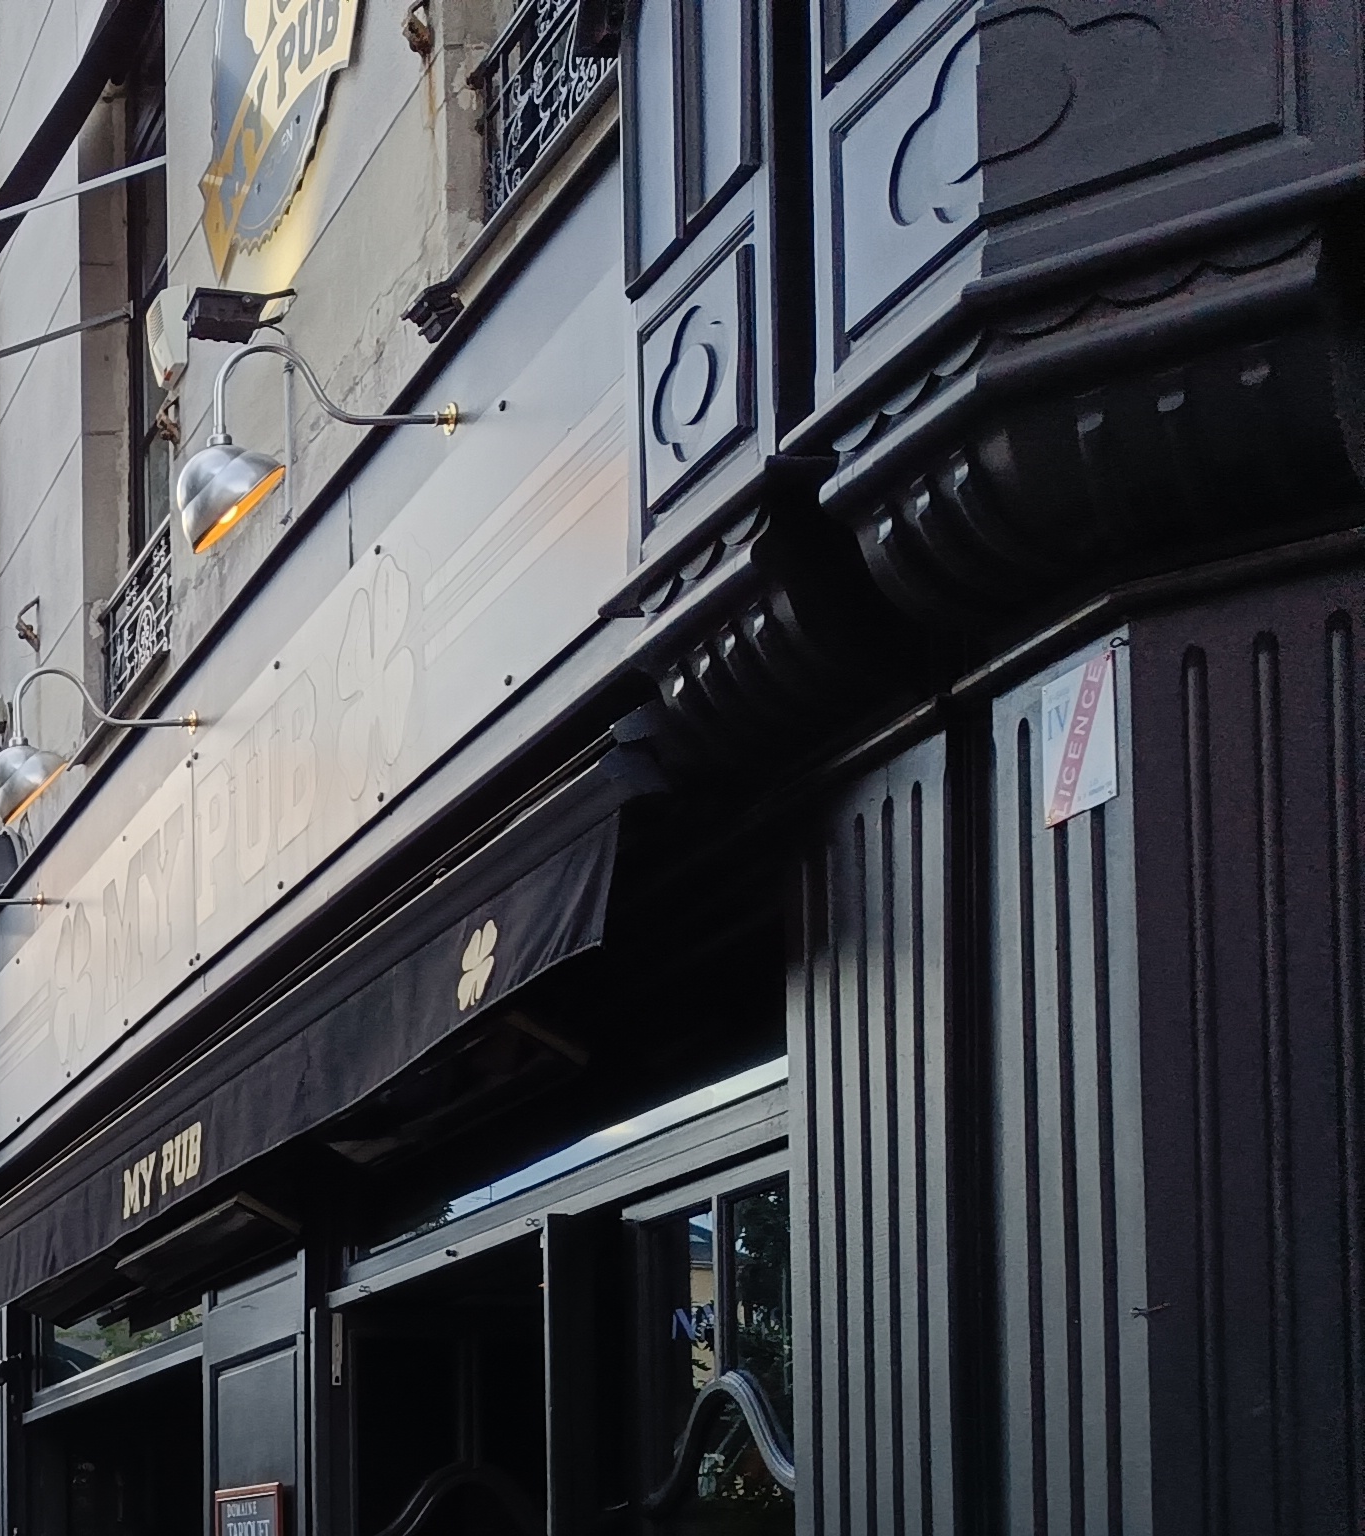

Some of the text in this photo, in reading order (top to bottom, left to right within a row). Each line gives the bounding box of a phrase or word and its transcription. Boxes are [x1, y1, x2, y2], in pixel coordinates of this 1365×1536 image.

[1053, 662, 1105, 819] LICENCE
[103, 669, 318, 1015] MY PUB
[123, 1121, 202, 1220] MY PUB
